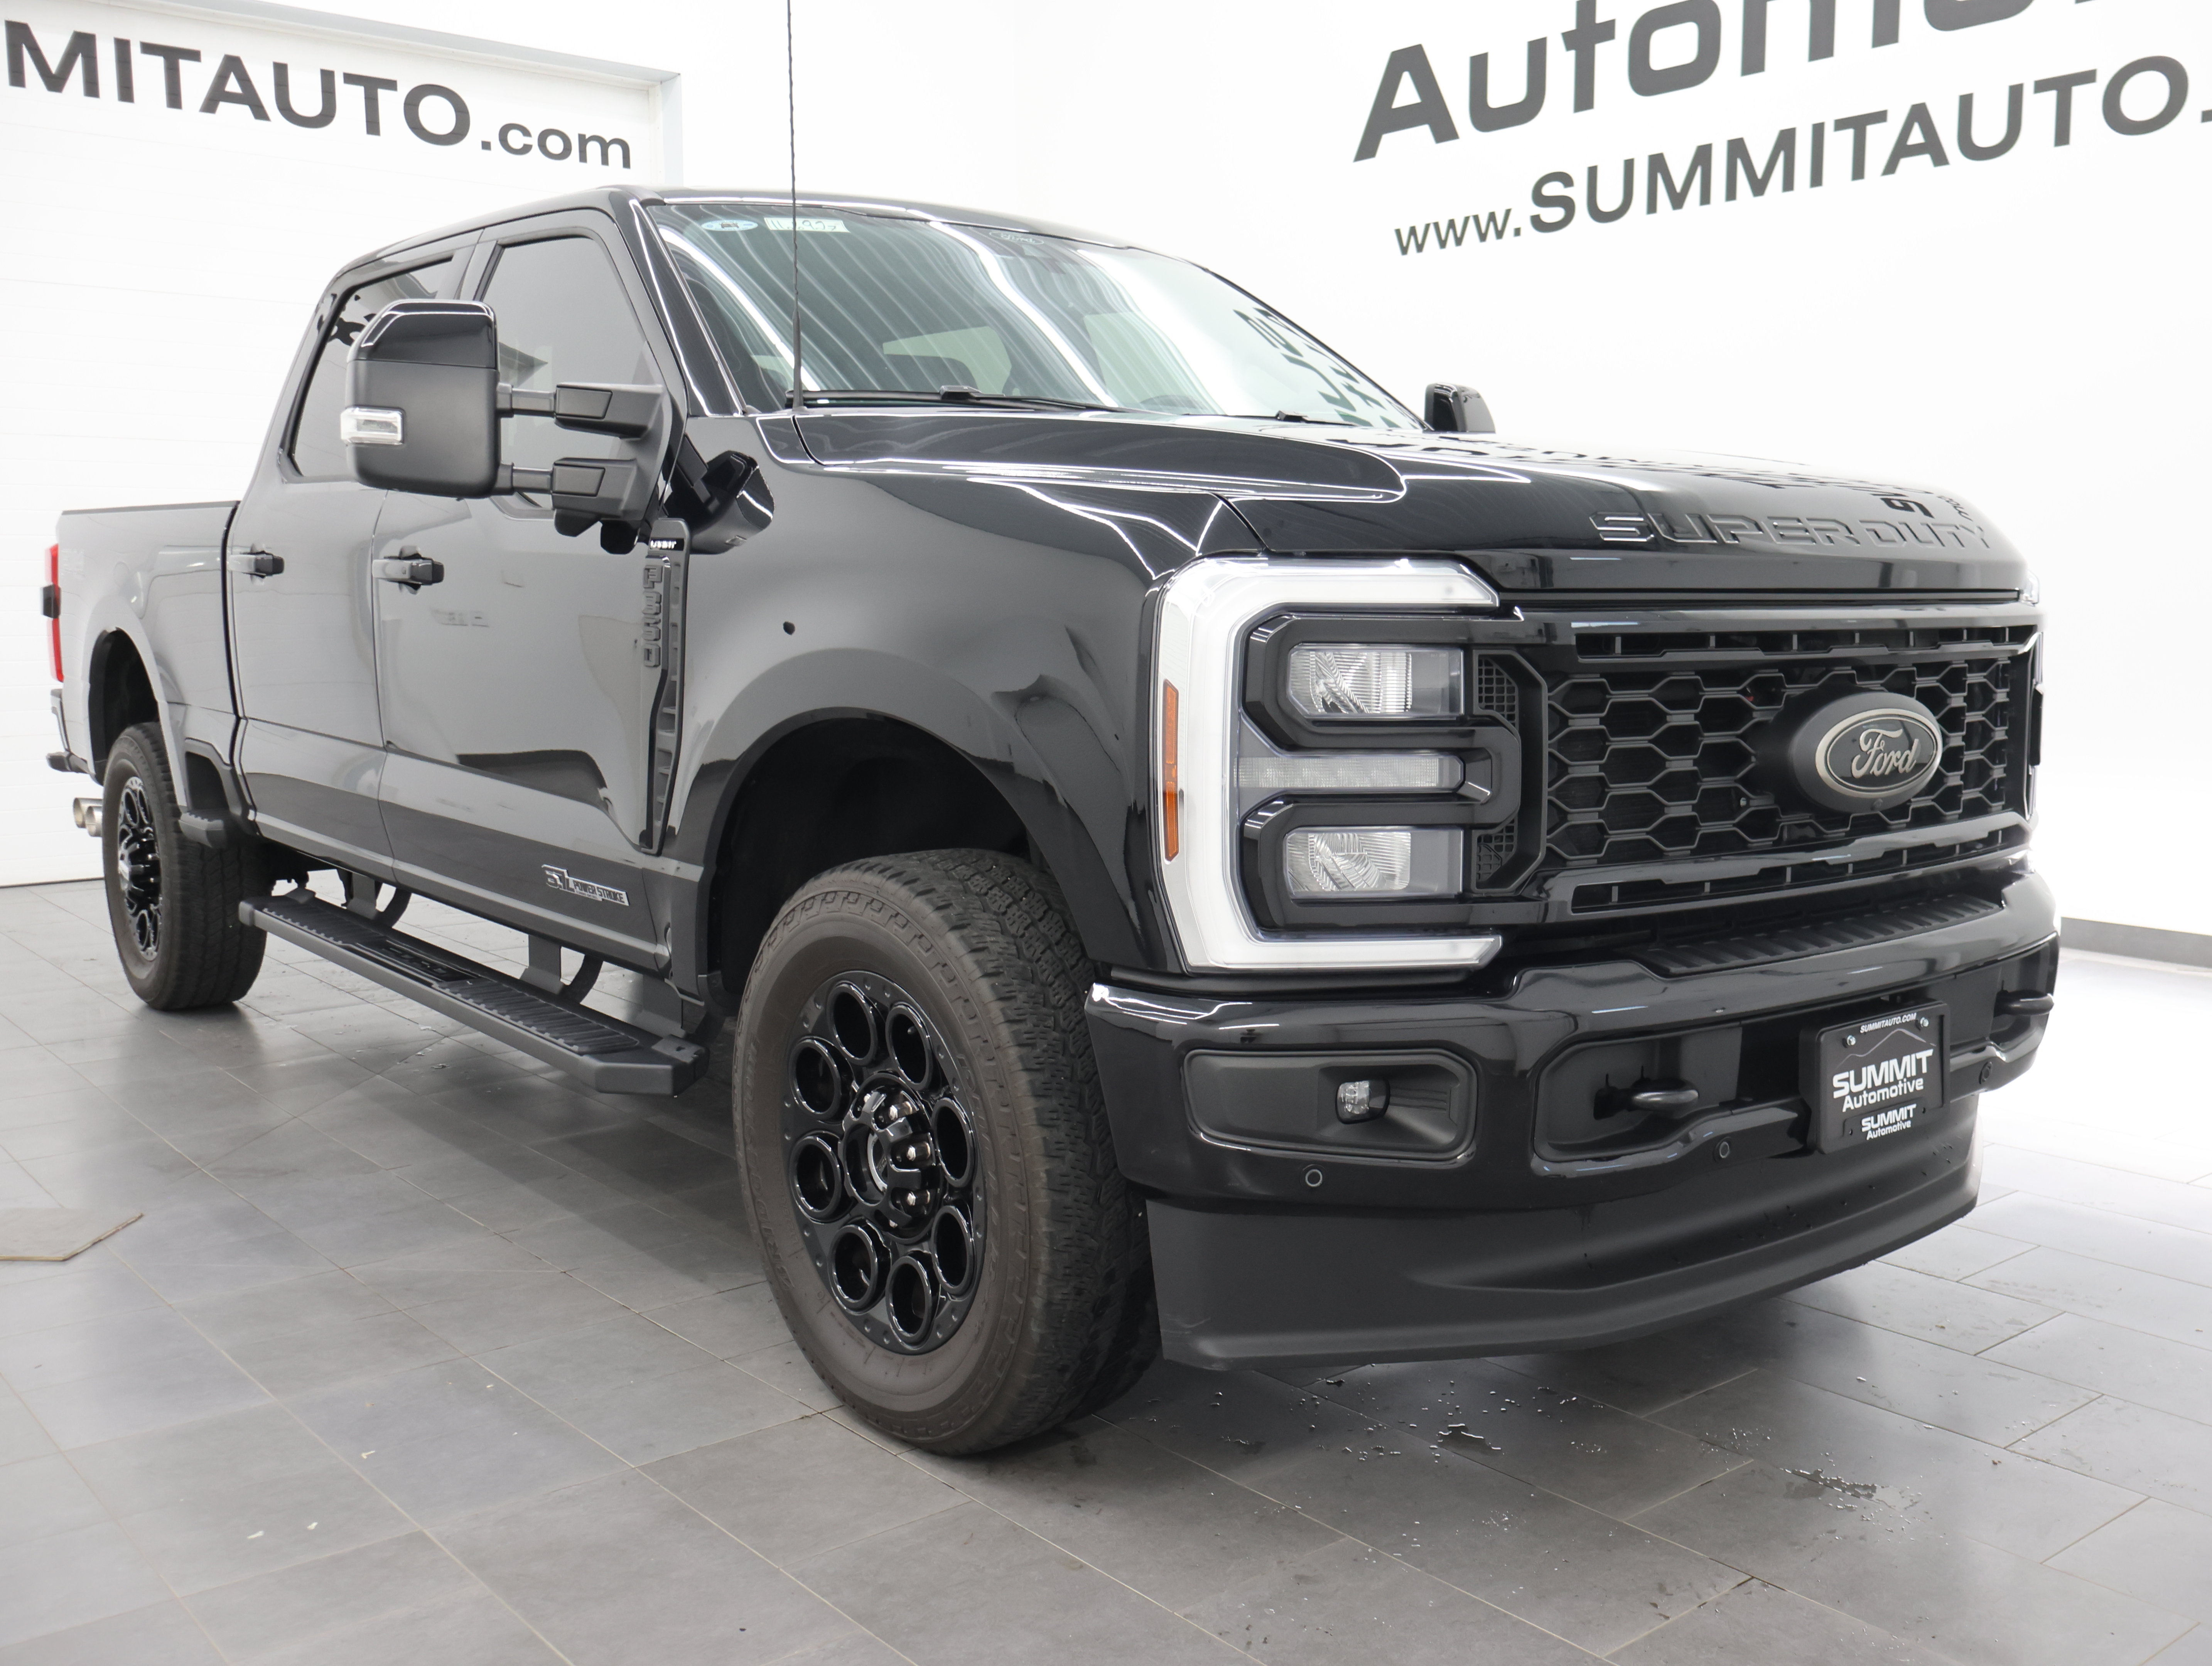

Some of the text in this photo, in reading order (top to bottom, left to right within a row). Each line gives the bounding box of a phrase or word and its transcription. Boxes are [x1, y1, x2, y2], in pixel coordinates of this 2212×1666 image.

[5, 20, 630, 169] MITAUTO.com
[1395, 56, 2212, 255] www.SUMMITAUTO.
[1589, 511, 1990, 549] SUPER DUTY
[1851, 728, 1919, 779] Ford
[597, 887, 625, 904] STROKE
[1860, 1013, 1916, 1033] SUMMITAUTO.COM
[1832, 1048, 1934, 1099] SUMMIT
[1842, 1078, 1924, 1112] Automotive
[1861, 1104, 1916, 1132] SUMMIT
[1866, 1120, 1911, 1140] Automotive
